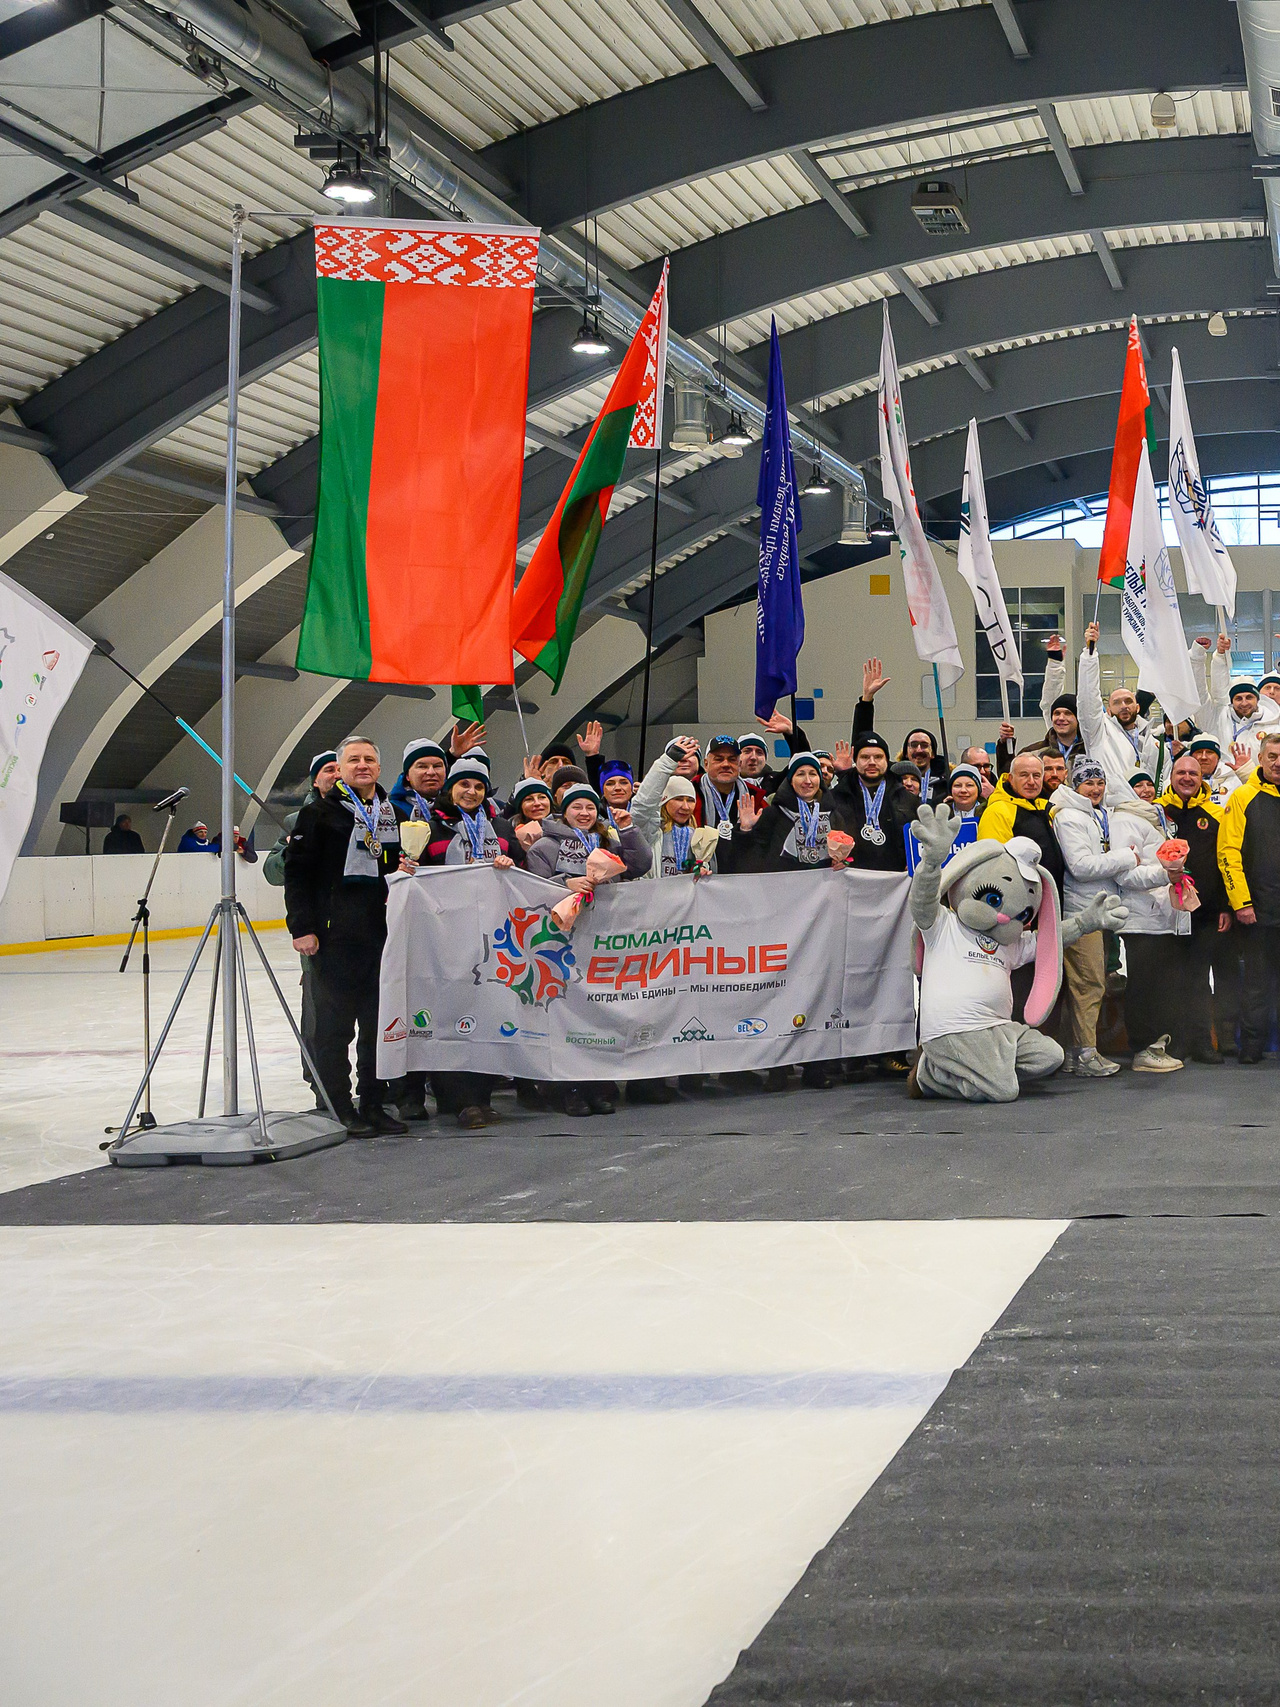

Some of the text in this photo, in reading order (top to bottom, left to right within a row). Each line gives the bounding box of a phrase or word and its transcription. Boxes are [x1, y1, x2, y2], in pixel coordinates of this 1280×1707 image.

[593, 924, 713, 950] КОМАНДА
[586, 943, 788, 991] ЕДИНЫЕ
[586, 993, 619, 1003] КОГДА
[621, 992, 639, 1001] МЫ
[641, 987, 676, 1000] ЕДИНЫ
[690, 983, 709, 993] МЫ
[711, 979, 787, 993] НЕПОБЕДИМЫ!
[565, 1036, 616, 1045] ВОСТОЧНЫЙ
